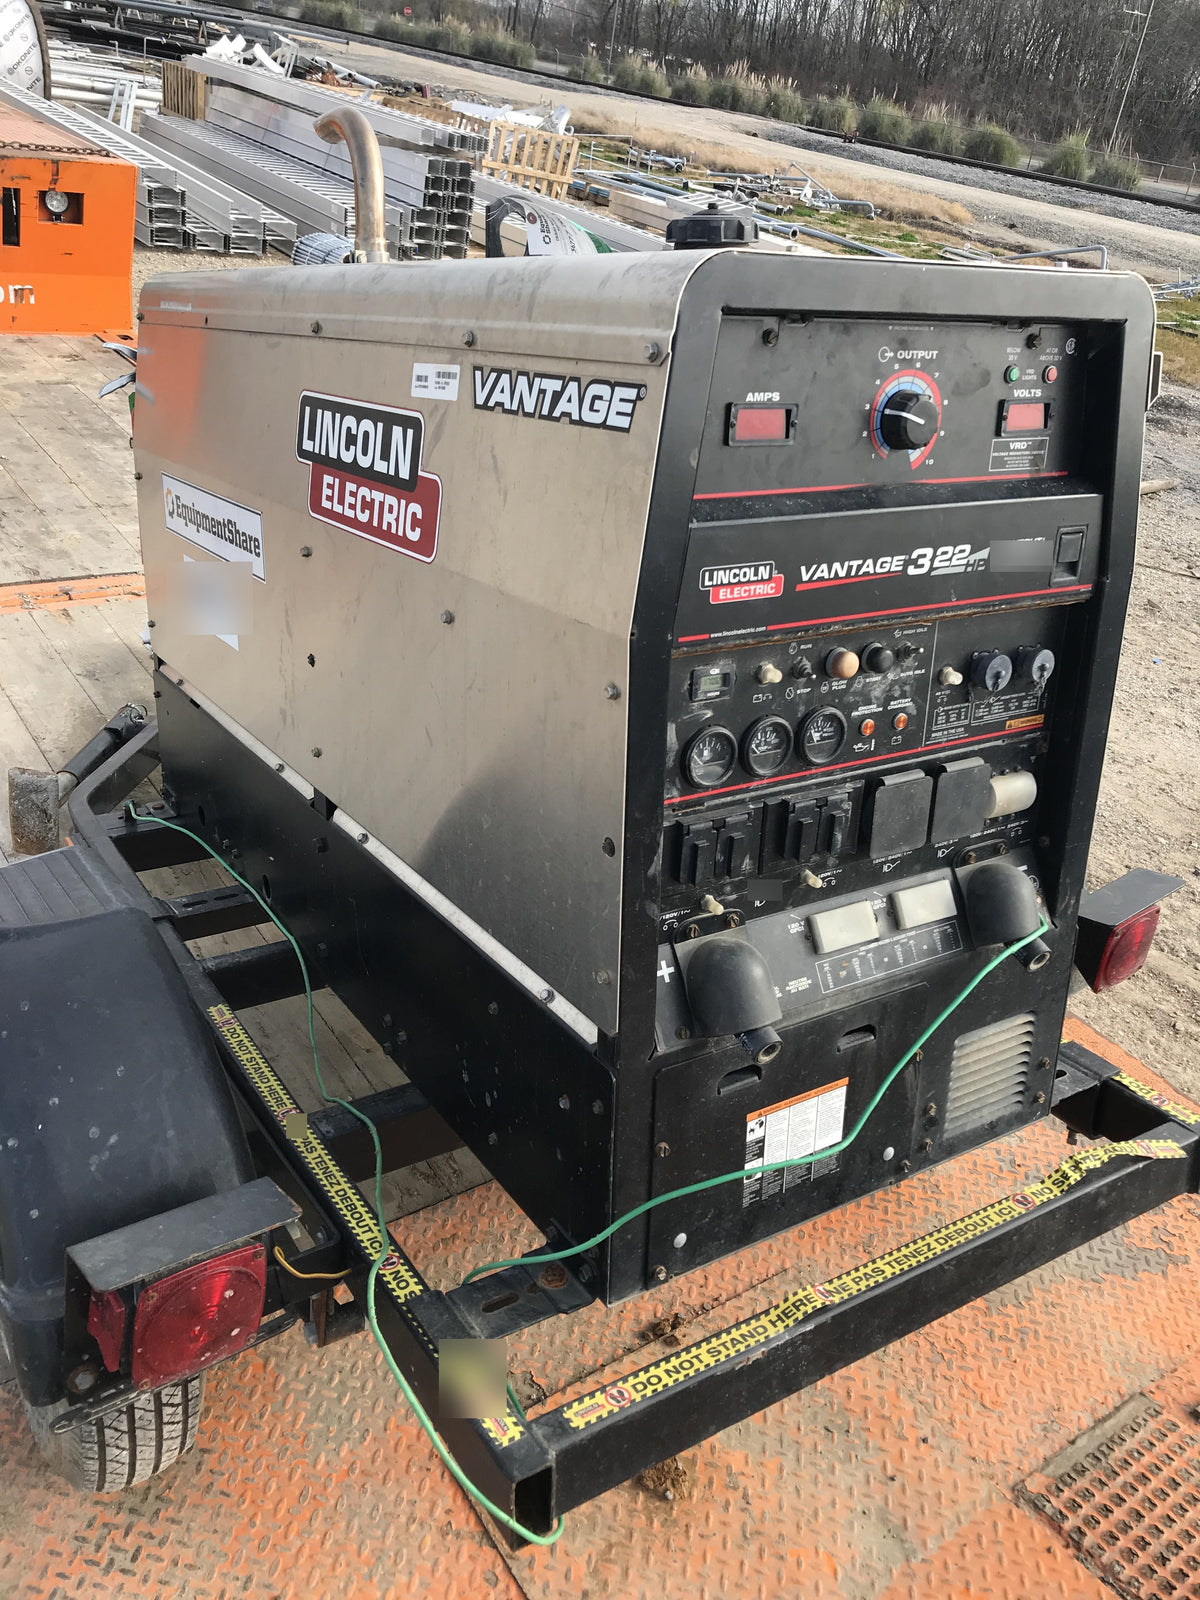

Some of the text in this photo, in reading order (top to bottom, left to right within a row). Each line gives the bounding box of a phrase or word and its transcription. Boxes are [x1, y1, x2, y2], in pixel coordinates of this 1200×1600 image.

[12, 41, 38, 70] OKONITE
[26, 76, 42, 91] NITE
[0, 284, 35, 304] m
[897, 350, 938, 359] OUTPUT
[474, 369, 640, 430] VANTAGE
[745, 392, 780, 402] AMPS
[1013, 389, 1042, 397] VOLTS
[302, 406, 414, 480] LINCOLN
[1009, 441, 1027, 449] VRD
[321, 474, 423, 542] ELECTRIC
[174, 494, 260, 557] EquipmentShare
[800, 555, 906, 582] VANTAGE
[907, 544, 972, 576] 322
[704, 565, 770, 586] LINCOLN
[719, 583, 776, 599] ELECTRIC
[710, 626, 766, 638] www.lincolnelectric.com
[851, 707, 883, 717] PROTECTION
[887, 702, 913, 710] CHARGING
[226, 1027, 287, 1109] DO NOT STAND HERE
[1030, 1186, 1053, 1199] NO
[312, 1153, 341, 1188] TENEZ
[334, 1187, 373, 1238] DEBOUT
[367, 1235, 384, 1255] IC
[828, 1204, 1017, 1299] NE PAS TENEZ DEBOUT ICI
[389, 1270, 410, 1290] NO
[631, 1292, 817, 1394] DO NOT STAND HERE
